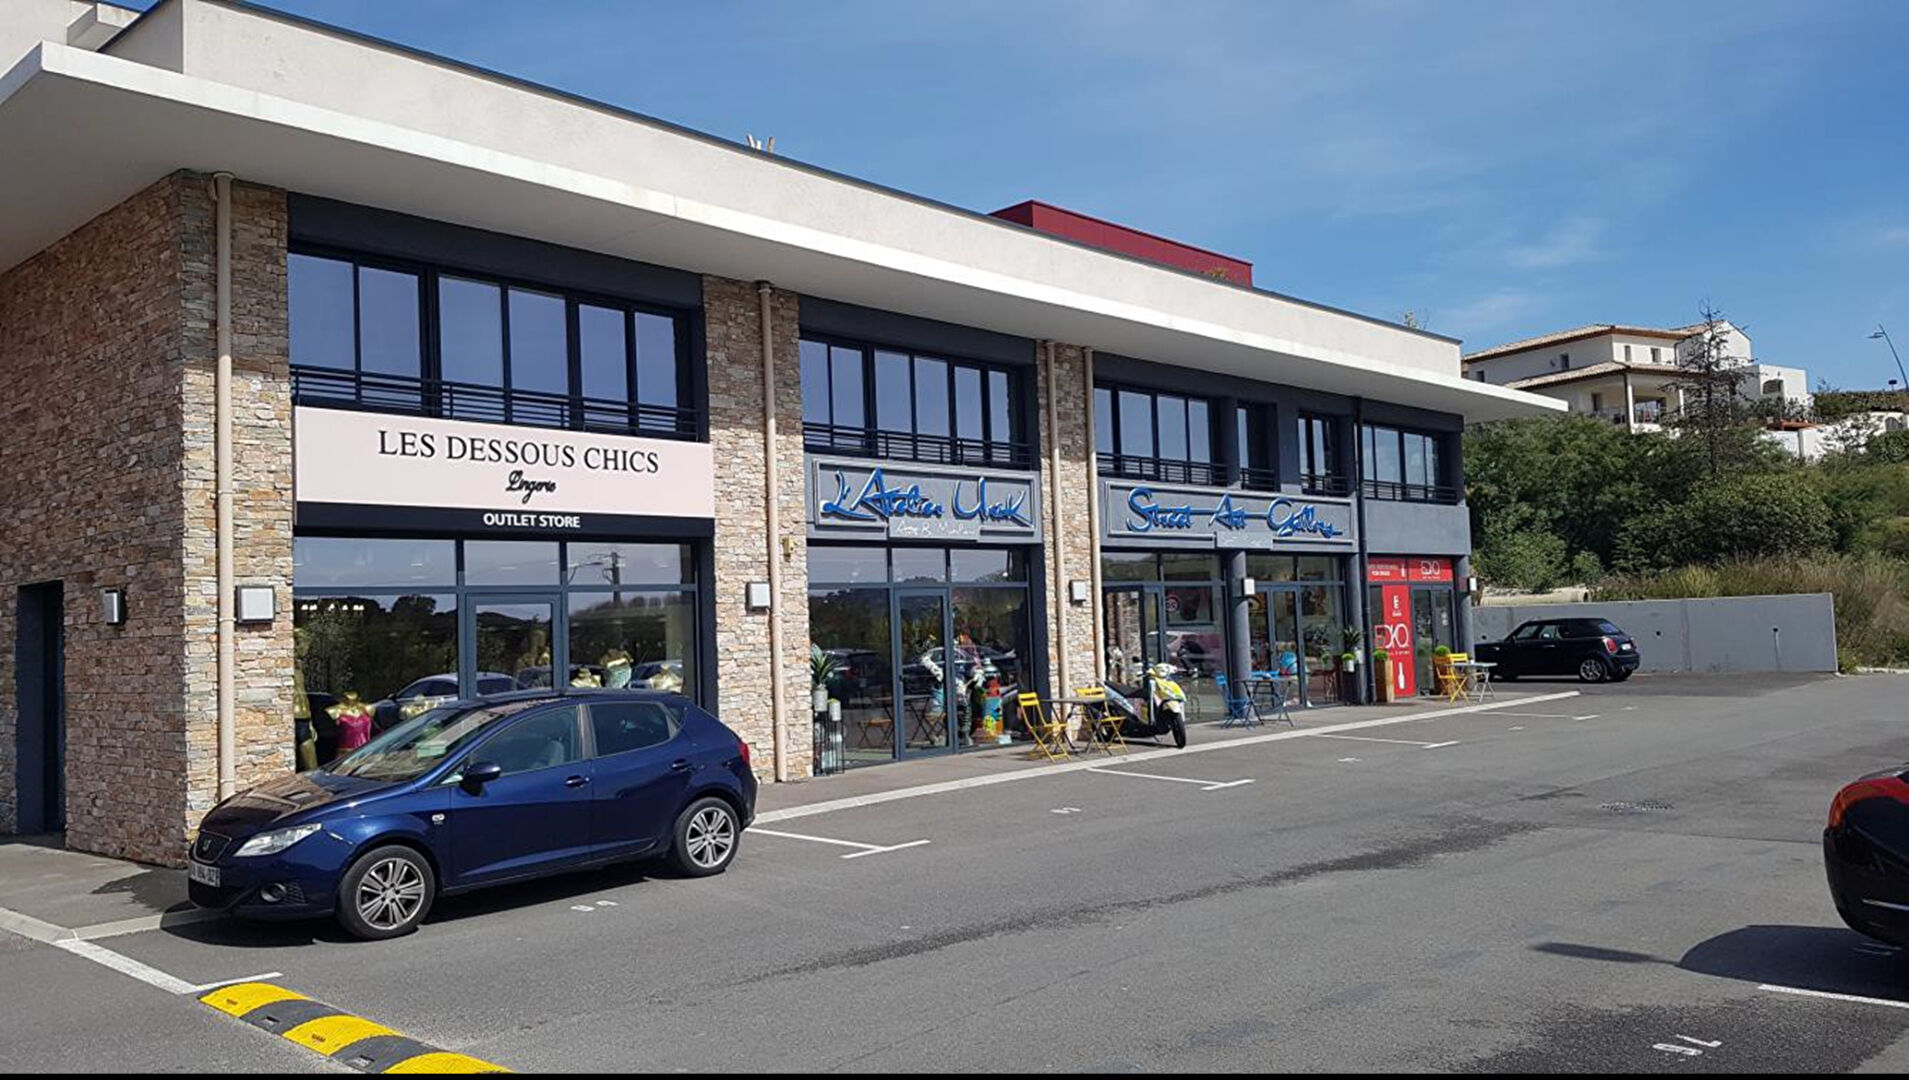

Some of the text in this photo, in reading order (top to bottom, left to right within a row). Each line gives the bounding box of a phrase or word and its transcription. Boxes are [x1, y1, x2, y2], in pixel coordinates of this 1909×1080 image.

[378, 430, 659, 473] LES DESSOUS CHICS
[505, 469, 557, 504] Lingerie
[483, 512, 581, 528] OUTLET STORE
[1126, 486, 1343, 539] Street Art Gallery
